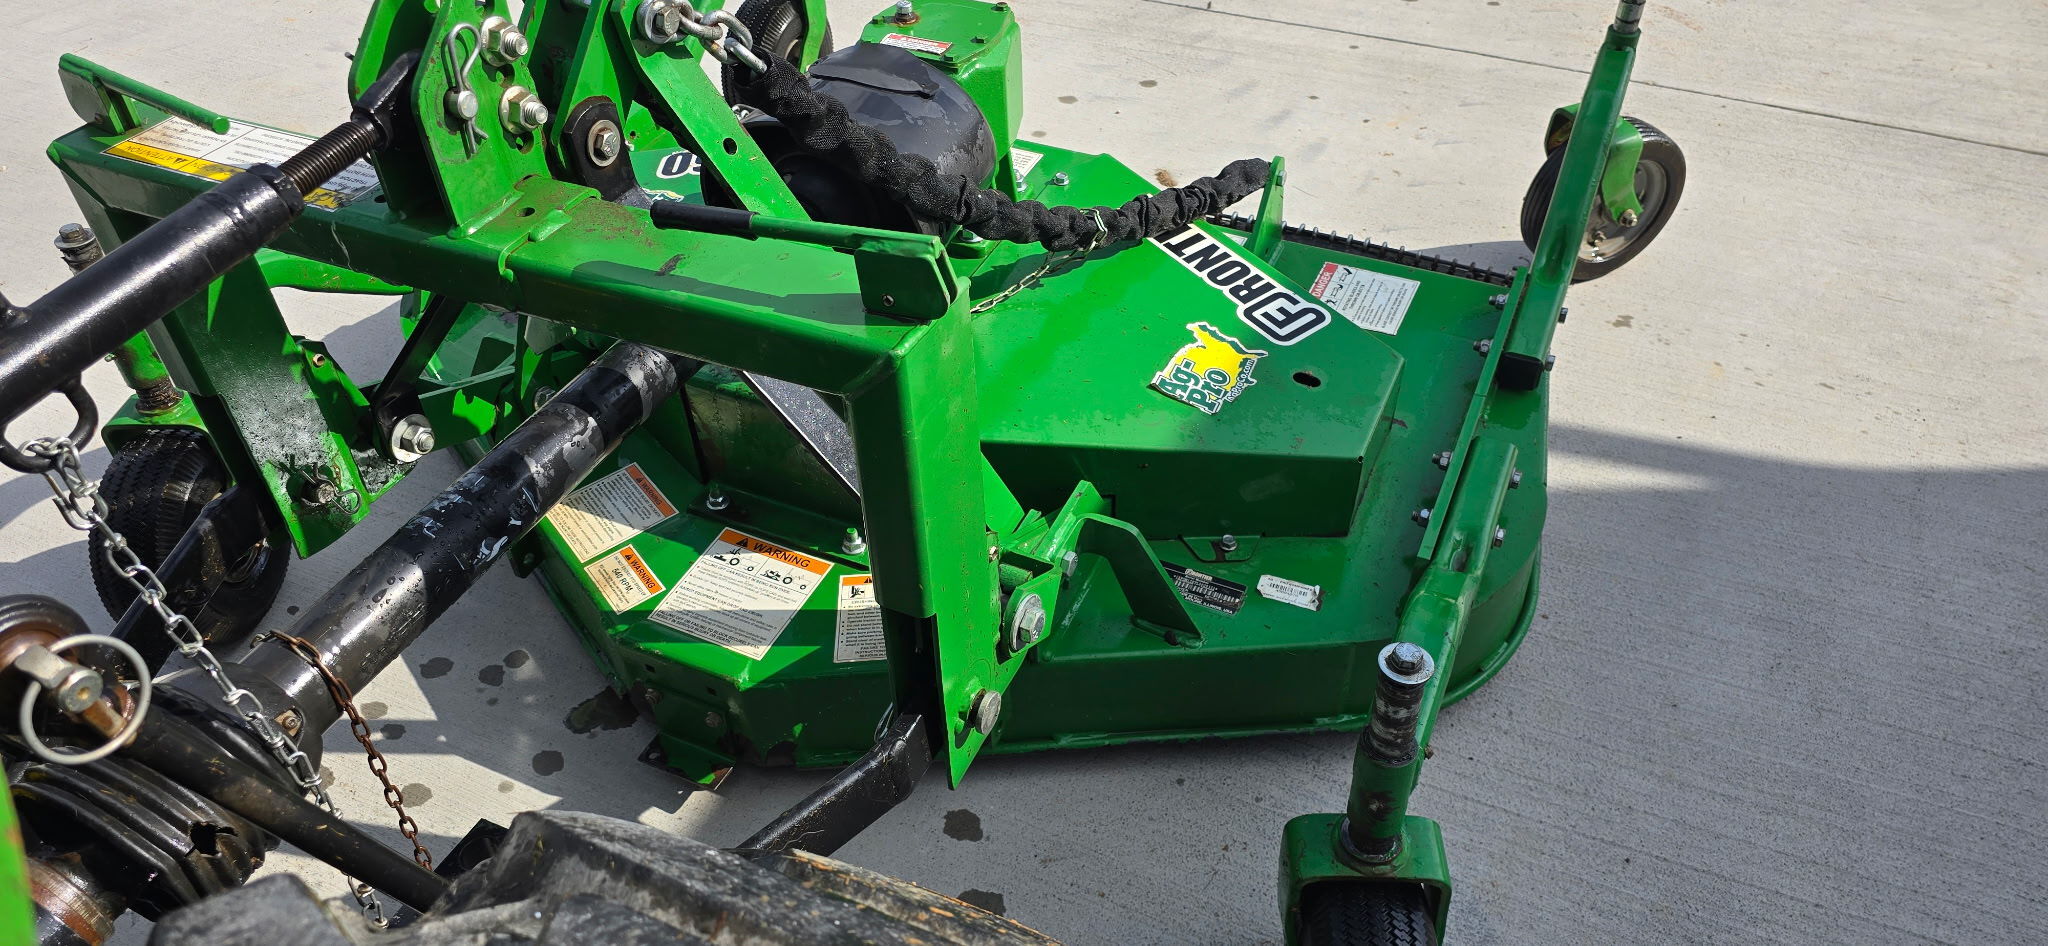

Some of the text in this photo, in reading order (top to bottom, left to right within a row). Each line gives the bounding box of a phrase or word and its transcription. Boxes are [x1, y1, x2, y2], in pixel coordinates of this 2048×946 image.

[1313, 271, 1333, 297] DANGER
[1157, 358, 1202, 399] Ag-
[1188, 368, 1231, 414] Pro
[753, 542, 811, 568] WARNING
[611, 567, 633, 592] 540 RPM
[629, 559, 655, 588] WARNING
